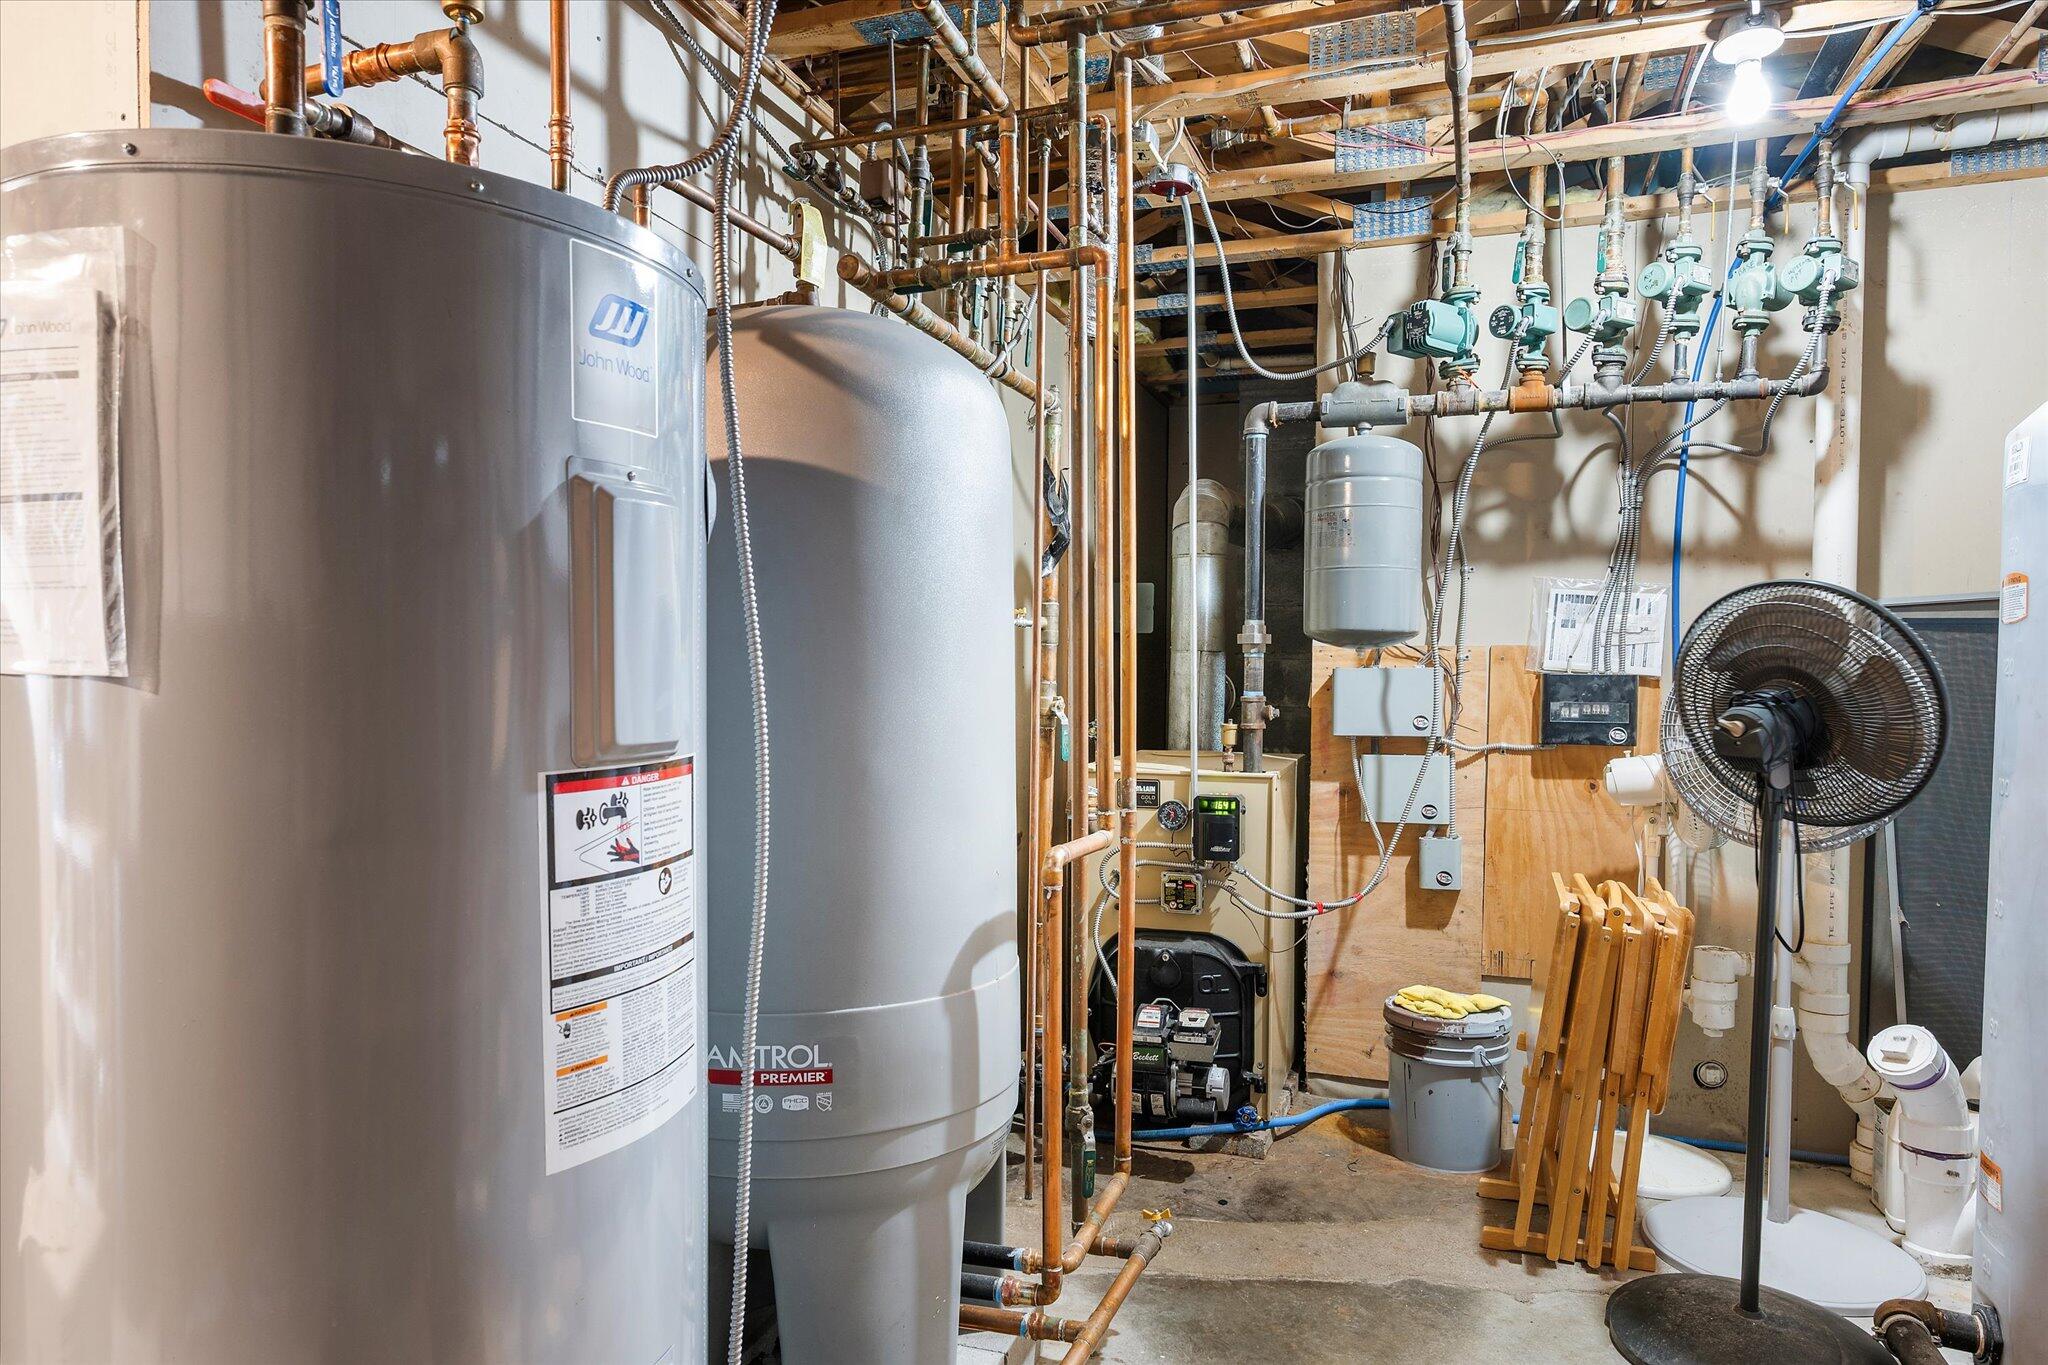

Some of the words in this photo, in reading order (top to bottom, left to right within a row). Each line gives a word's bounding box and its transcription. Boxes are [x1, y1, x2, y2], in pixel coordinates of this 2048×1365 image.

[329, 17, 337, 58] American
[331, 65, 339, 88] Valve
[578, 348, 614, 374] John
[615, 357, 650, 383] Wood
[631, 772, 660, 785] DANGER
[1132, 1051, 1159, 1061] Beckett
[760, 1072, 826, 1084] PREMIER
